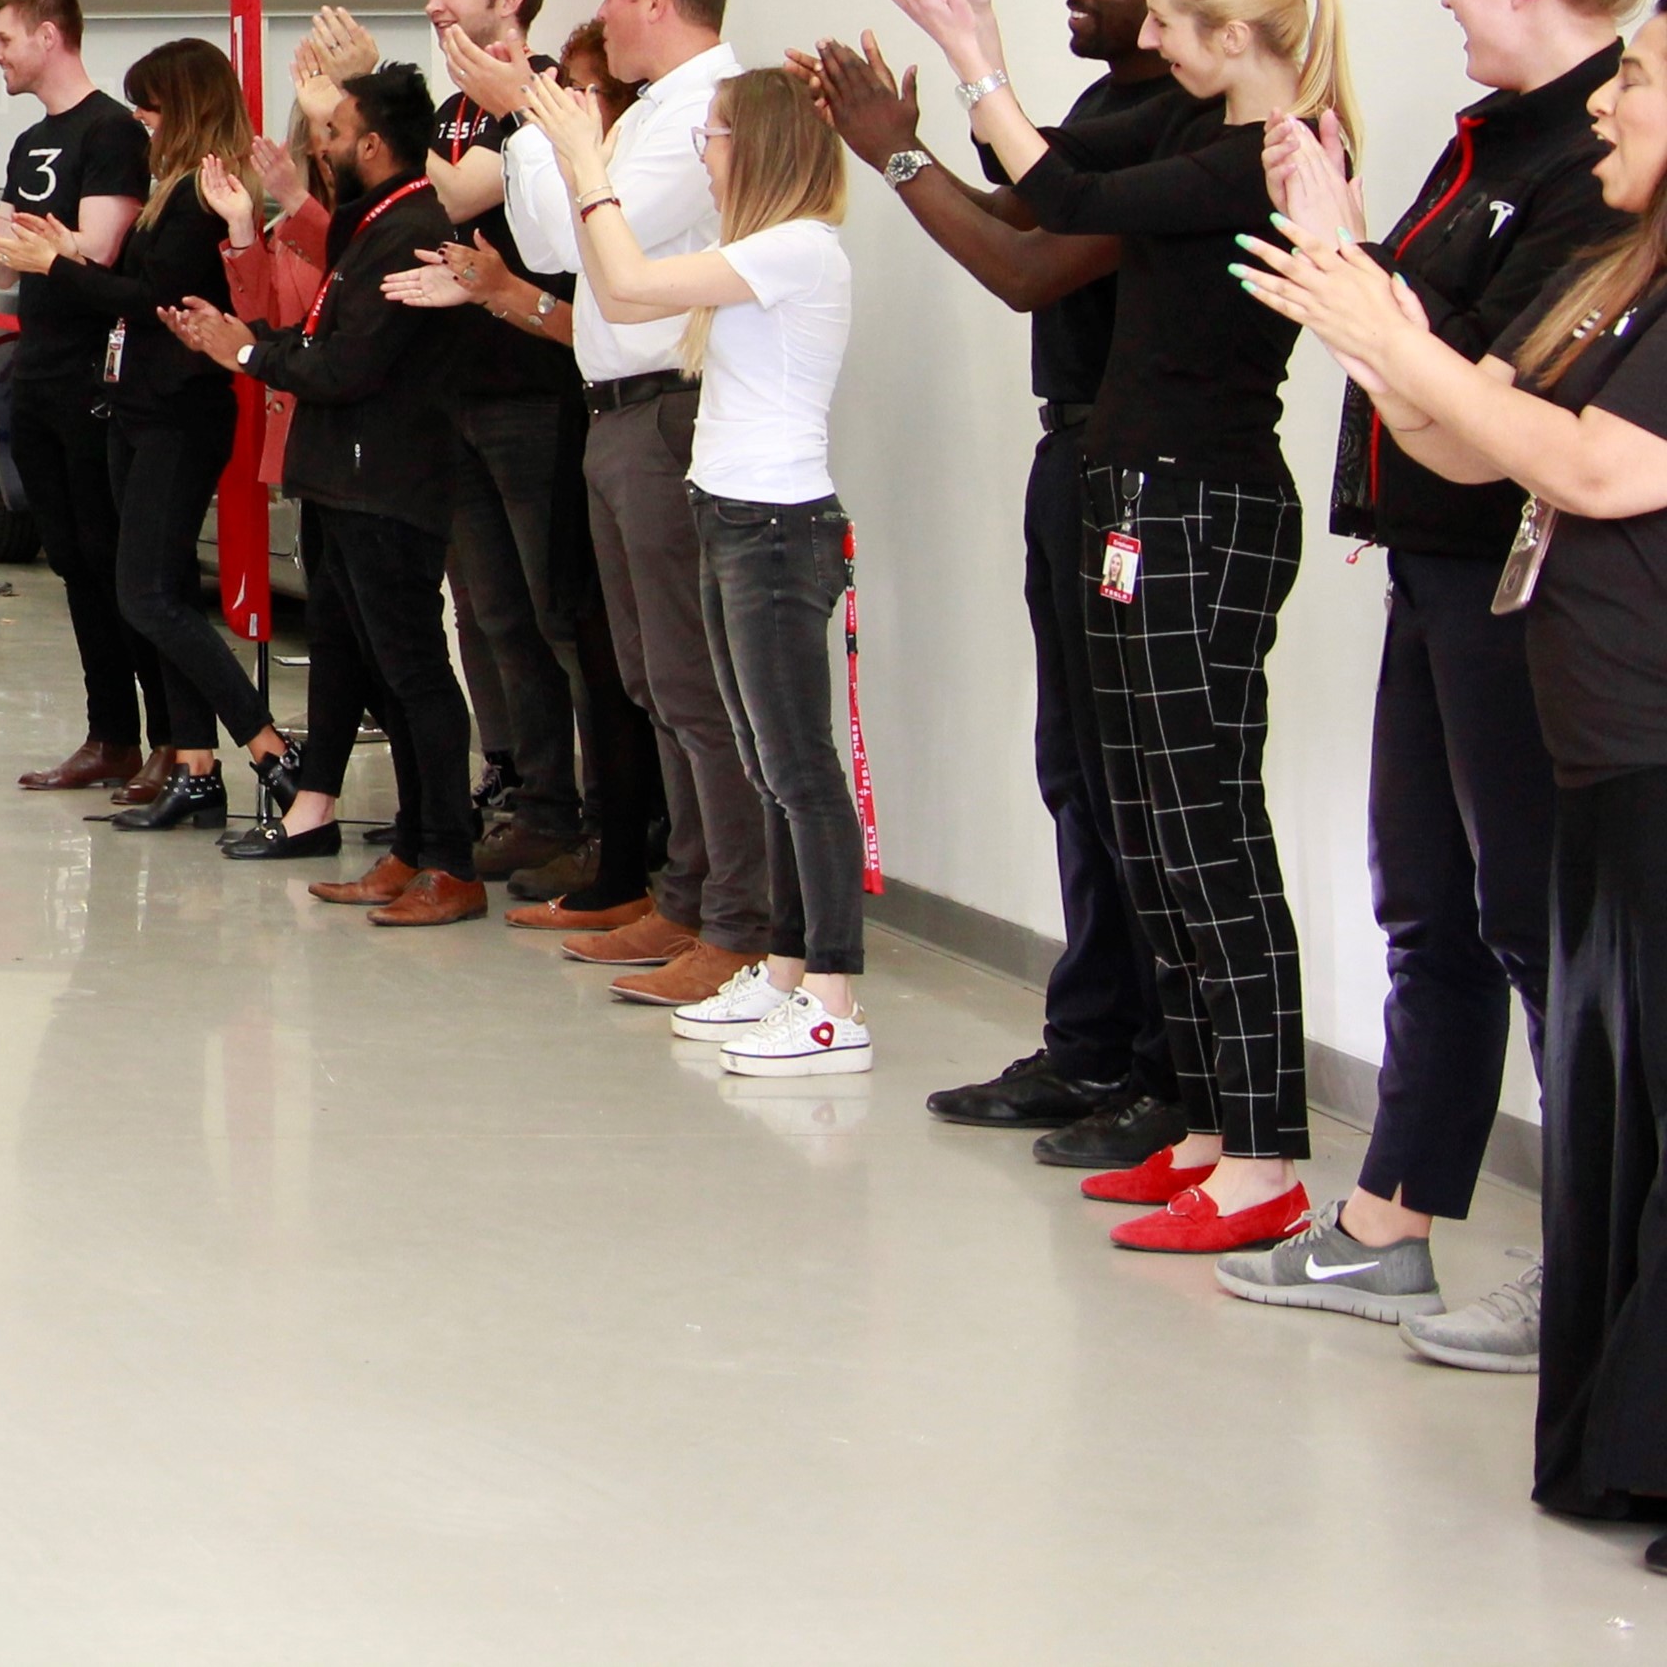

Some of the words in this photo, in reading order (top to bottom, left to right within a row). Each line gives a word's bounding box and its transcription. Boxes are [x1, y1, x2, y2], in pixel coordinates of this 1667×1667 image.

[18, 148, 63, 202] 3
[365, 199, 392, 222] TESLA
[867, 825, 878, 870] TESLA
